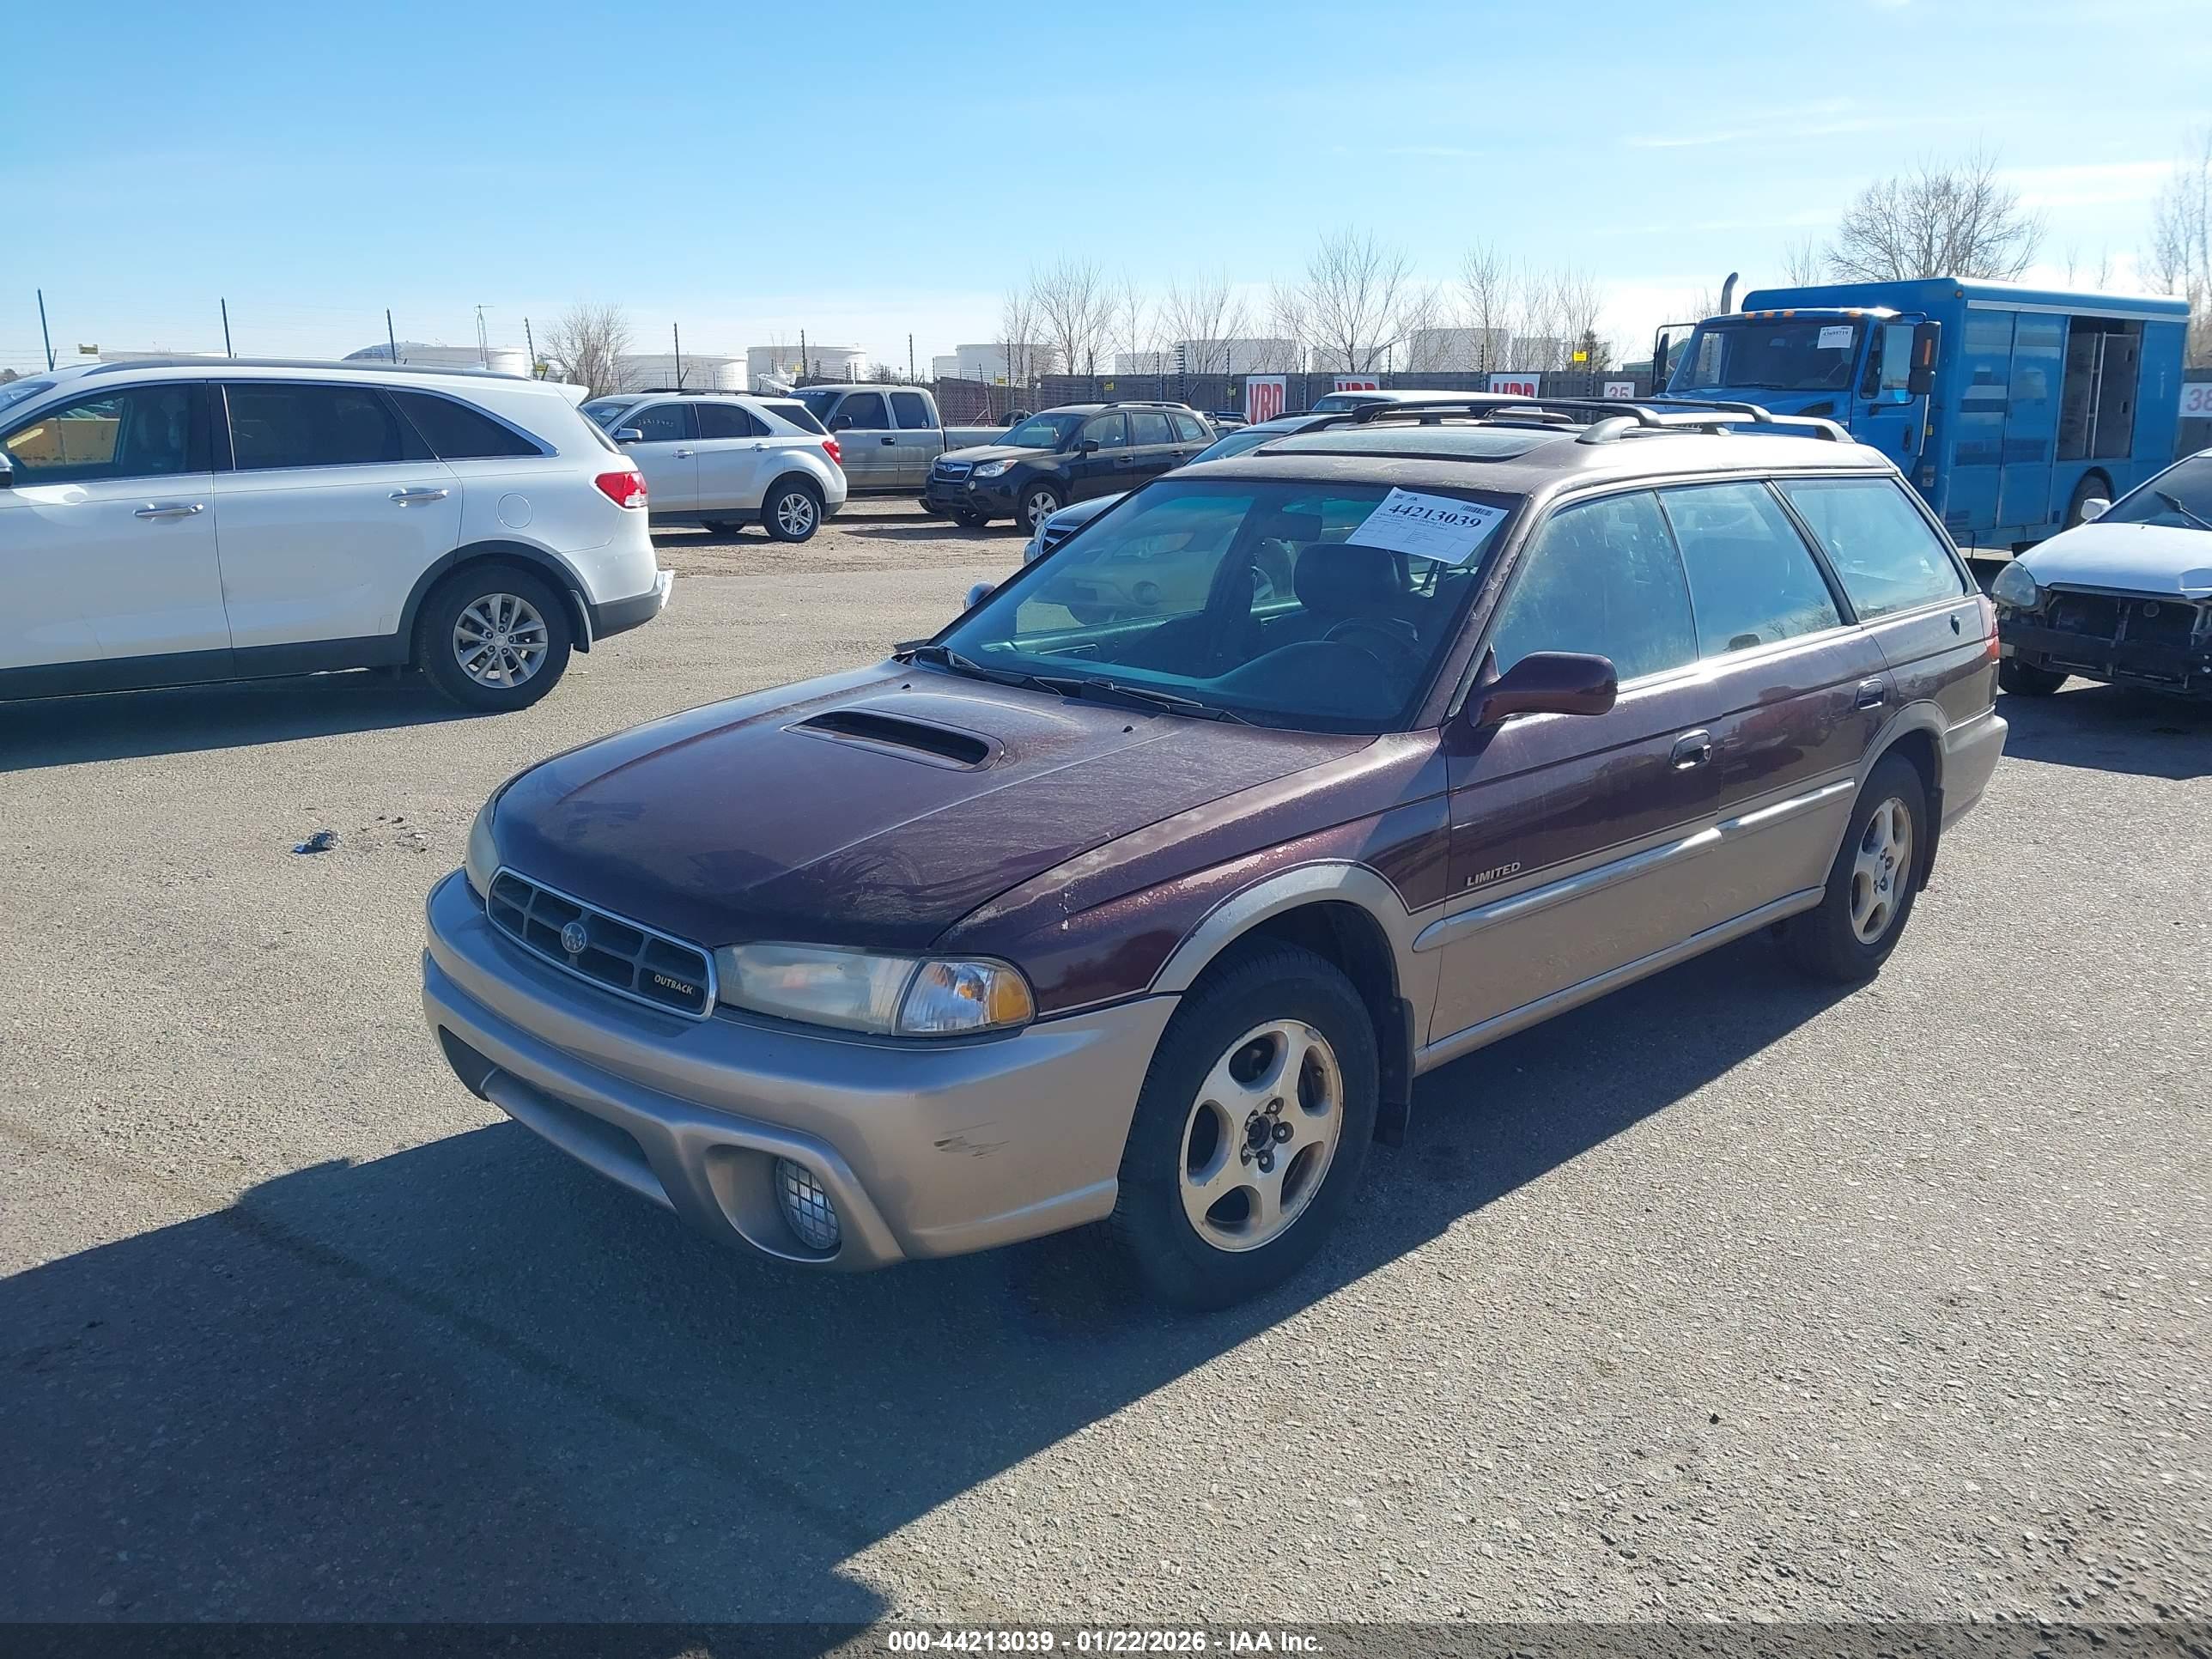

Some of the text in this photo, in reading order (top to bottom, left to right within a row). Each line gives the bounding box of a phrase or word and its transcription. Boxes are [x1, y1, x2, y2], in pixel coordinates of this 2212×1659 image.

[1388, 503, 1482, 528] 44213039
[1467, 861, 1522, 887] LIMITED
[653, 974, 694, 994] OUTBACK
